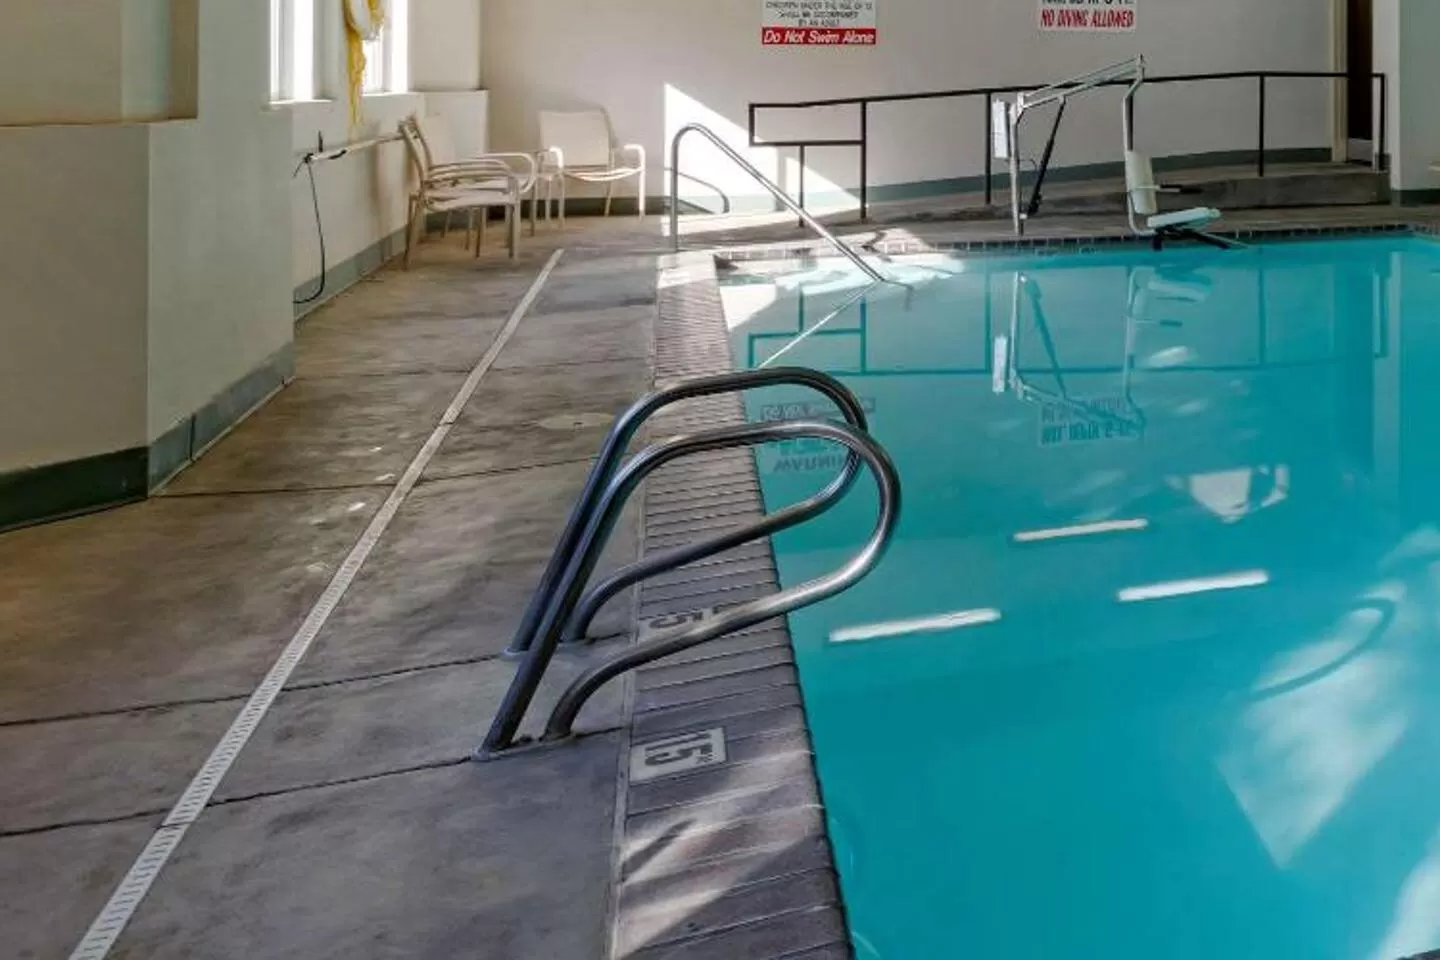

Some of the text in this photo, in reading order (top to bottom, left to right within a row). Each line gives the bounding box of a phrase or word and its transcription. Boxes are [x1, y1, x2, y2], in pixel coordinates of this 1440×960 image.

[1041, 9, 1135, 28] NO DIVING ALLOWED
[763, 30, 875, 44] Do Not Swim Alone
